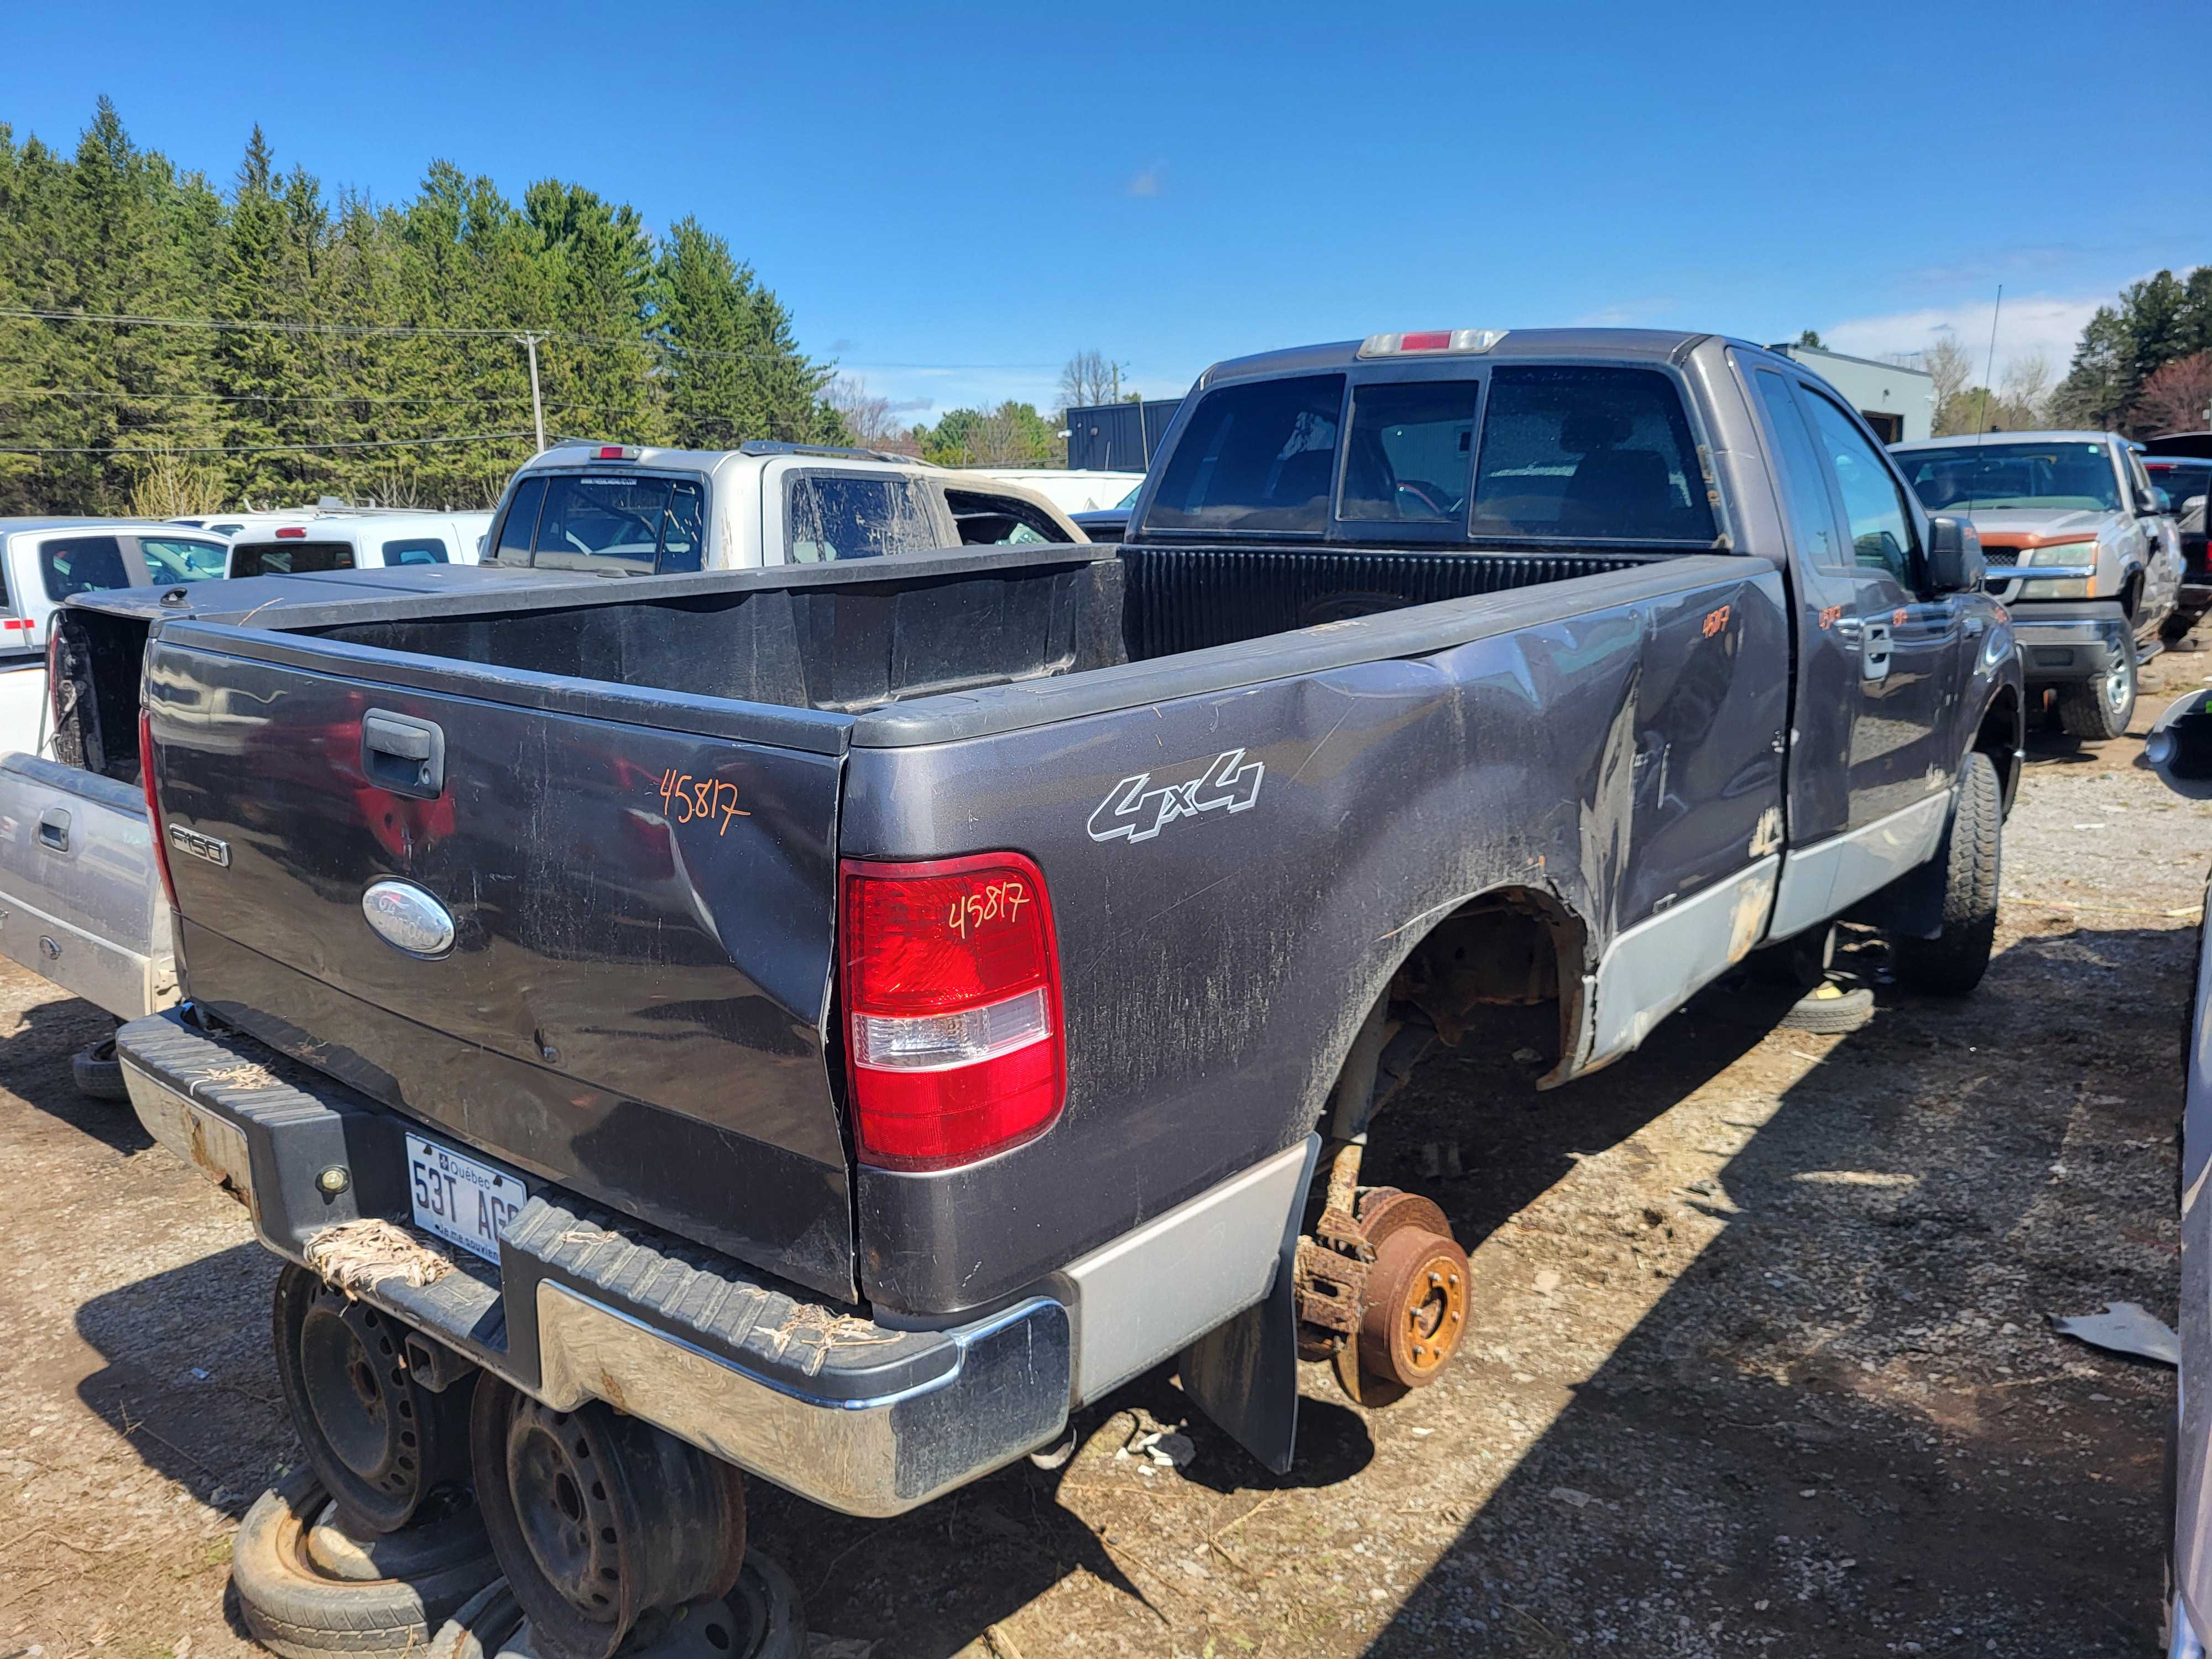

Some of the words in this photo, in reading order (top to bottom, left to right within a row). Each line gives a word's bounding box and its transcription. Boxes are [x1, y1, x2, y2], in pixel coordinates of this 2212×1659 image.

[660, 768, 751, 836] 45817
[948, 881, 1030, 939] 45817
[413, 1160, 457, 1223] 53T
[450, 1161, 491, 1190] Québec
[451, 1230, 464, 1243] me
[465, 1238, 499, 1261] souvien
